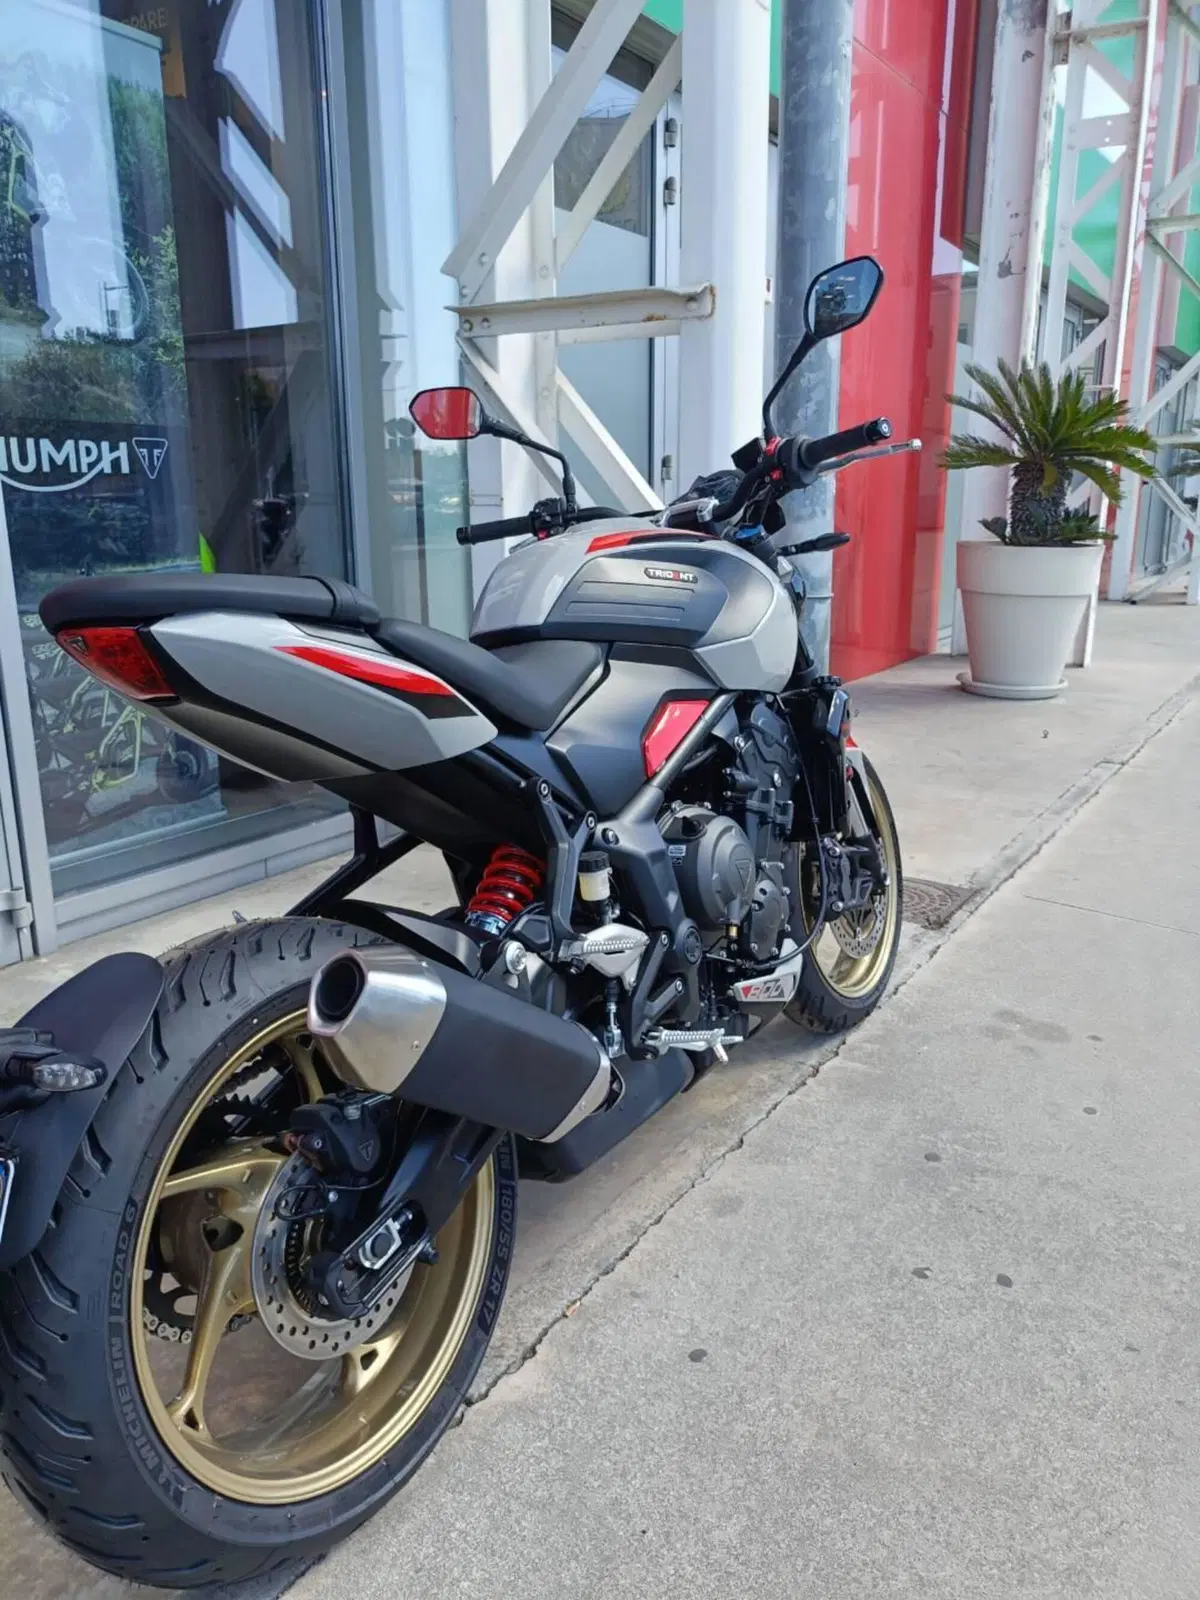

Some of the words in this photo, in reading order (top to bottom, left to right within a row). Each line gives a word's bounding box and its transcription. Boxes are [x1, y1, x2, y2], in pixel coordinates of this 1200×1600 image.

[648, 569, 694, 581] TRIDENT
[498, 1187, 515, 1260] 180/55
[111, 1231, 130, 1309] ROAD
[489, 1267, 504, 1295] ZR
[481, 1298, 496, 1322] 17
[111, 1337, 160, 1471] MICHELIN
